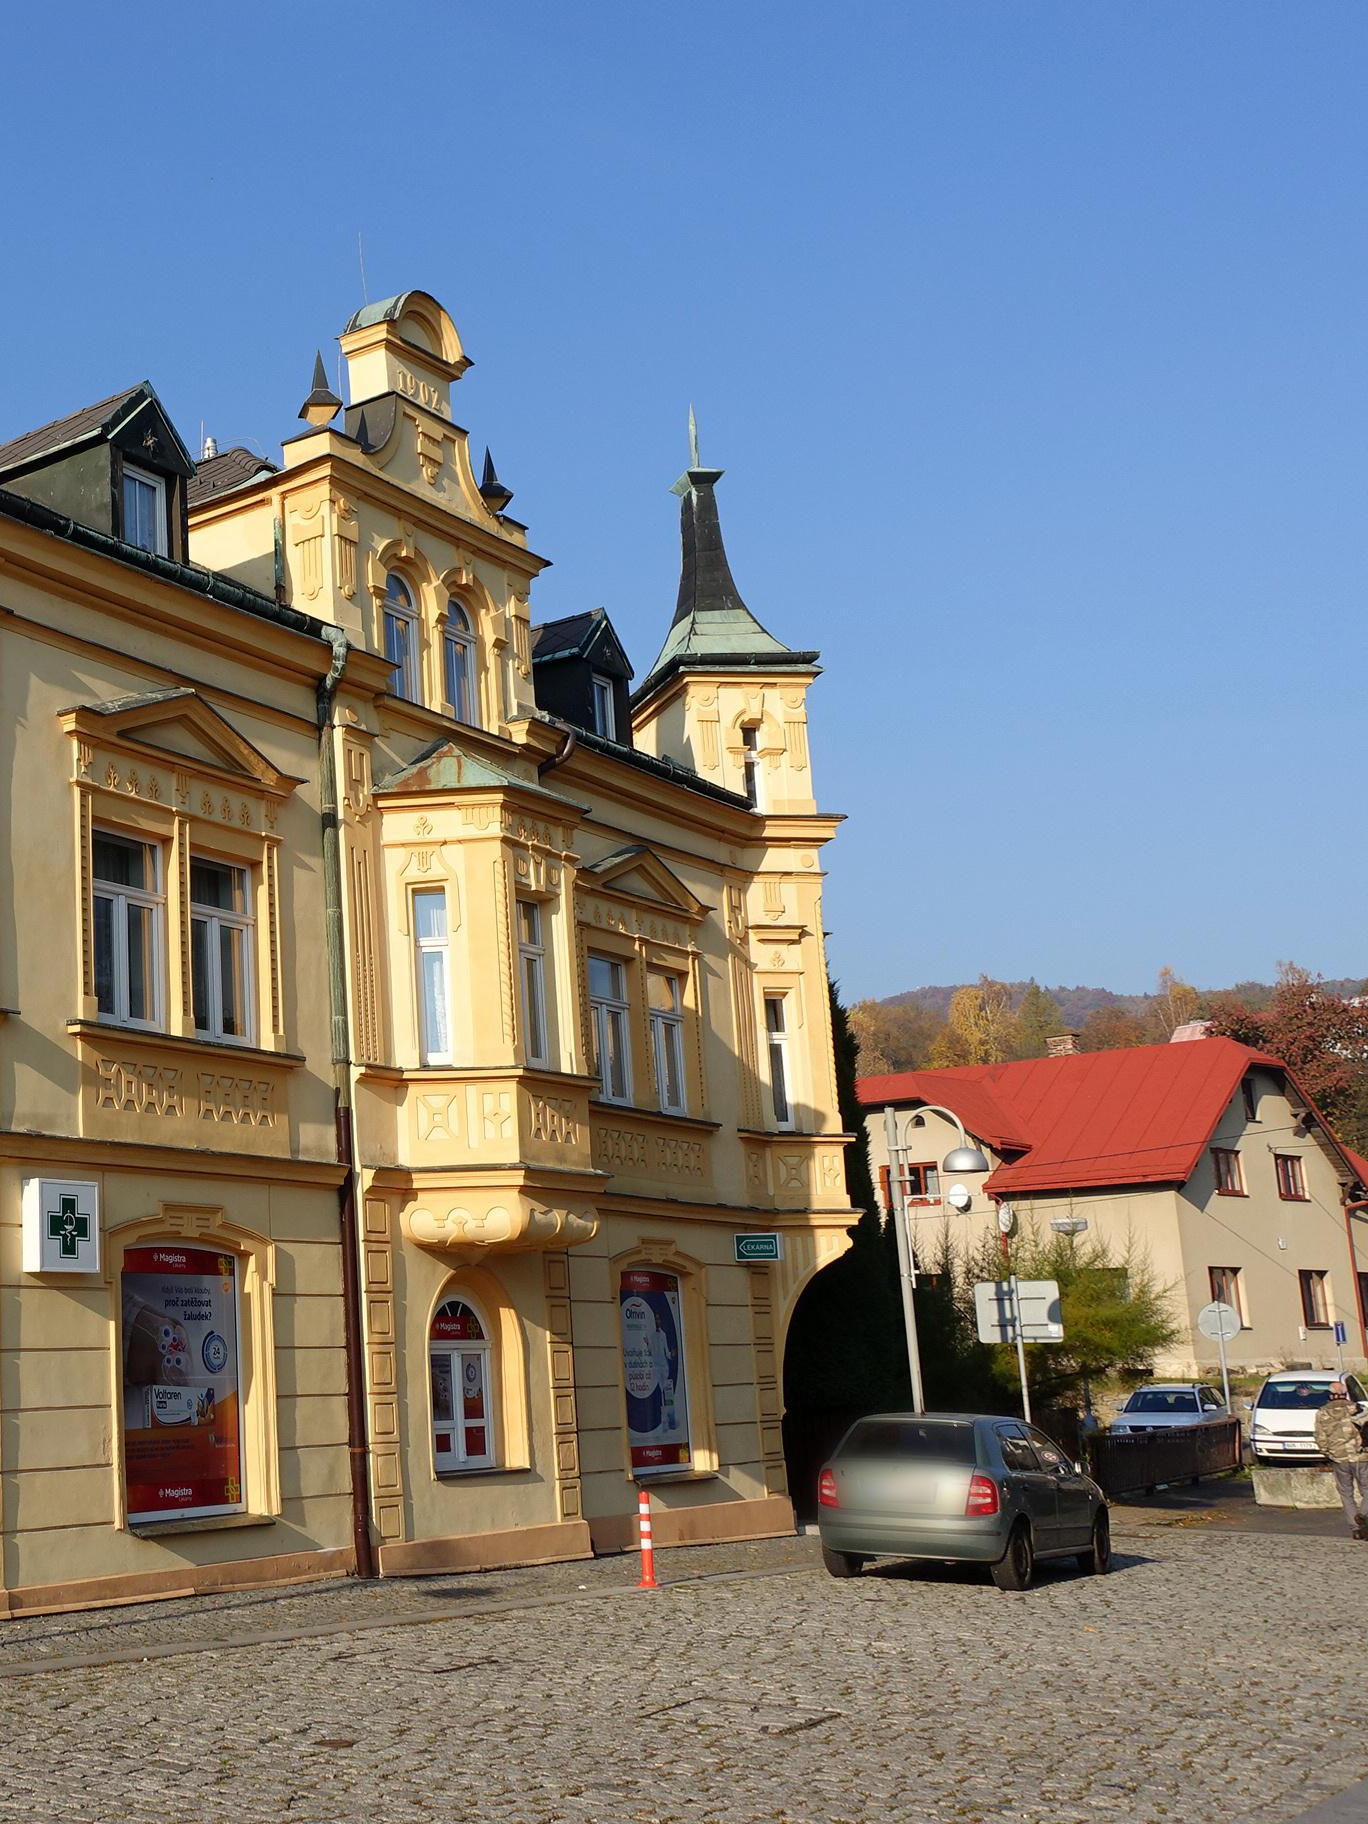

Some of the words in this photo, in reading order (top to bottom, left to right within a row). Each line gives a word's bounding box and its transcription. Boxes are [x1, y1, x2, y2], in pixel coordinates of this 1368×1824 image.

[397, 369, 441, 411] 1902
[159, 1253, 186, 1263] Magistra
[164, 1297, 179, 1309] proč
[180, 1297, 212, 1308] zatěžovat
[183, 1311, 212, 1321] žaludek?
[153, 1388, 182, 1400] Voltaren
[165, 1488, 192, 1497] Magistra
